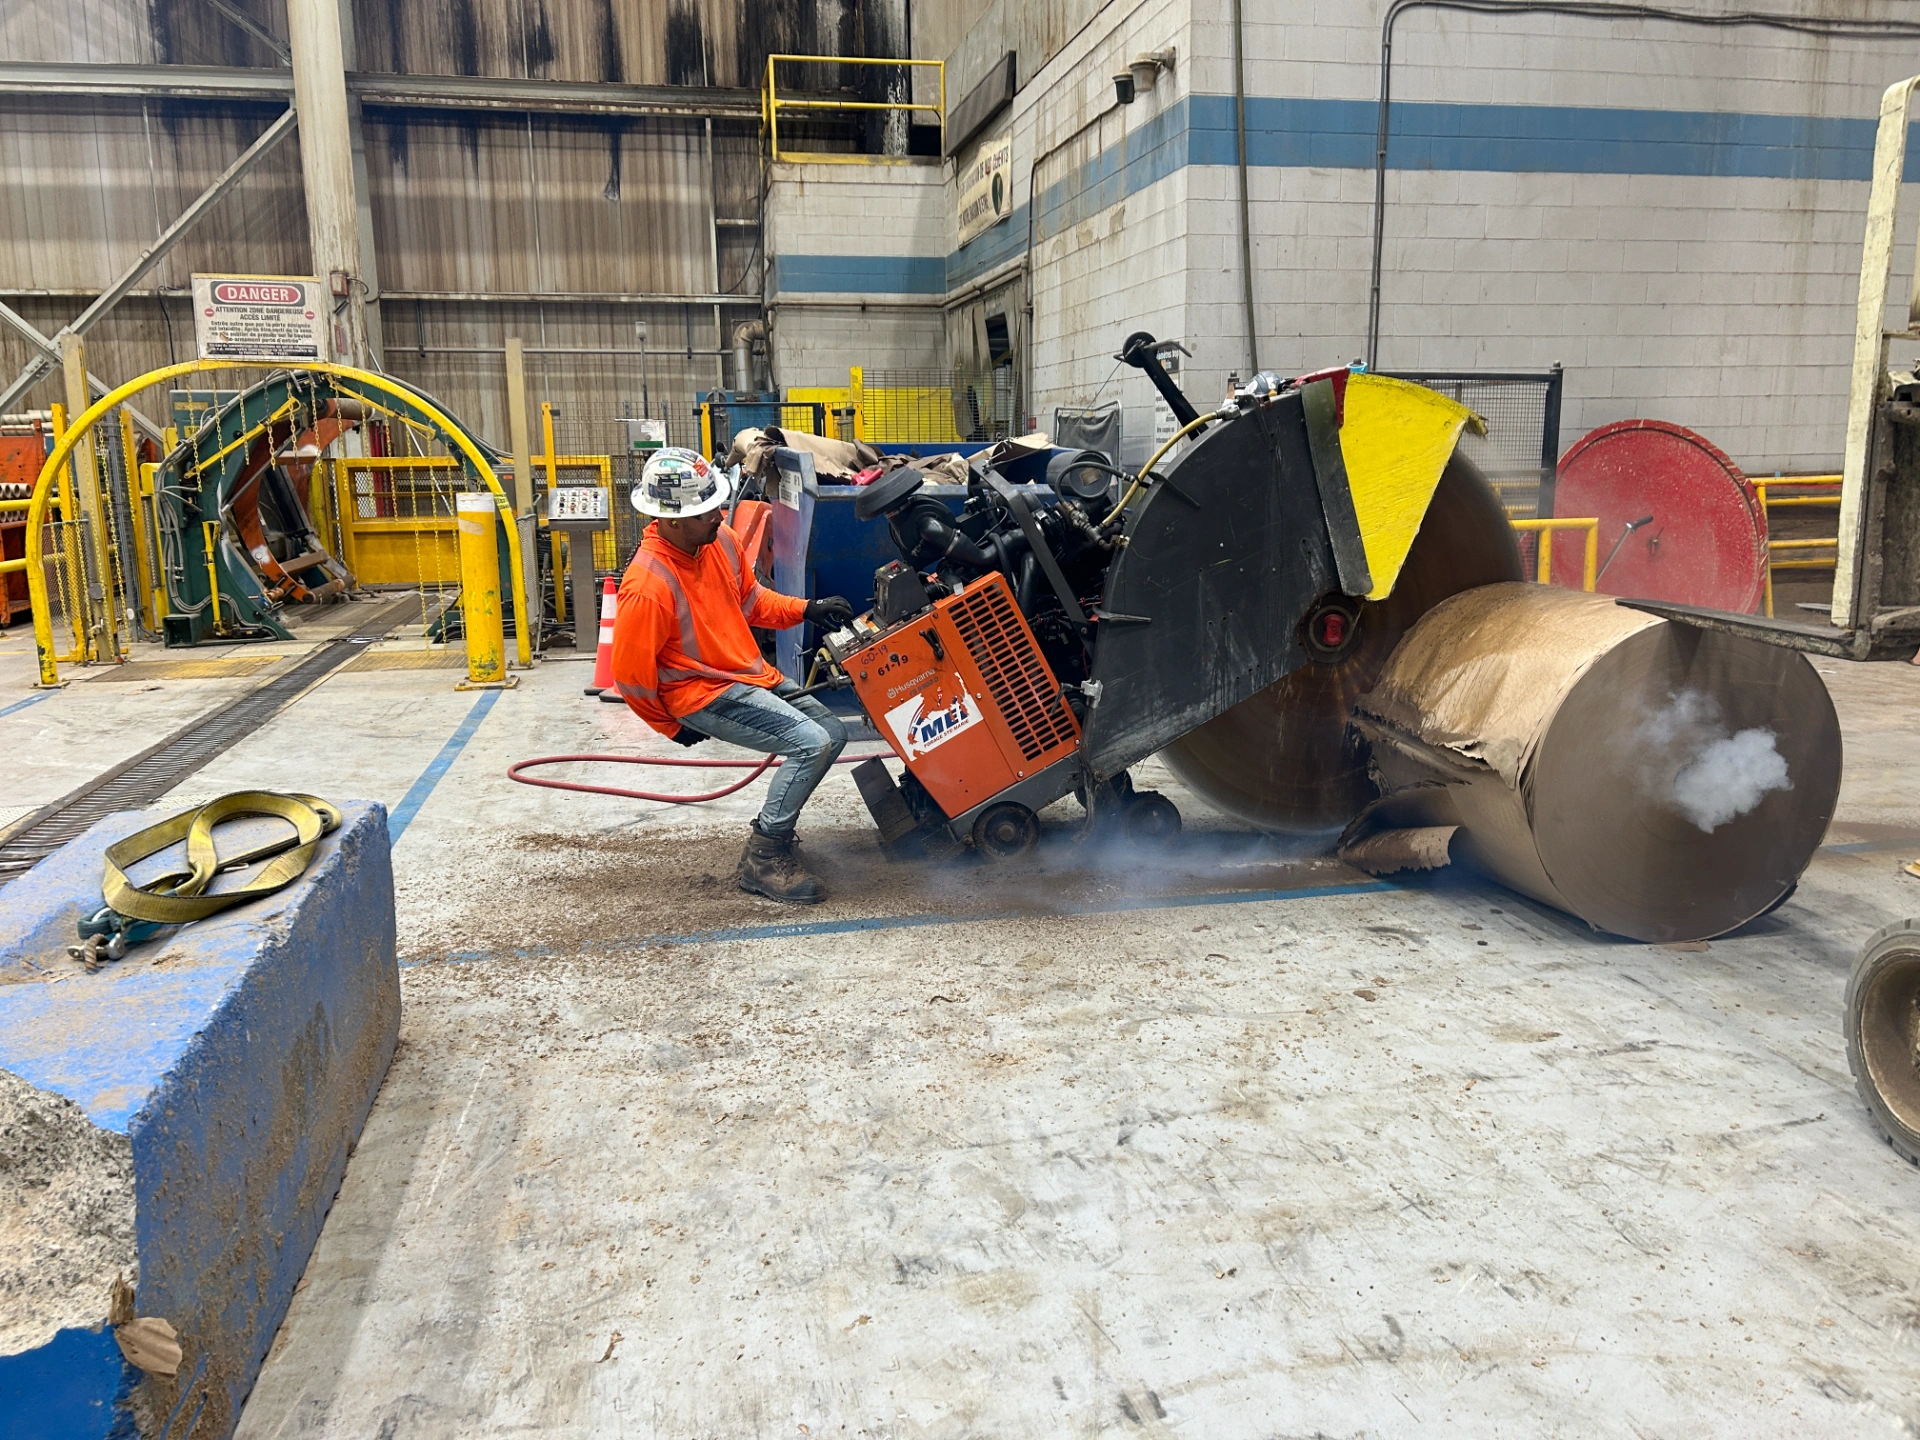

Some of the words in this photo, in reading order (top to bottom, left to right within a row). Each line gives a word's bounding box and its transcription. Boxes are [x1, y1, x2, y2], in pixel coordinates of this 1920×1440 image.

[227, 286, 289, 301] DANGER
[877, 654, 909, 677] 61-19
[894, 667, 936, 694] Husqvarna
[923, 734, 944, 748] FORAGE
[953, 718, 969, 731] MARIE
